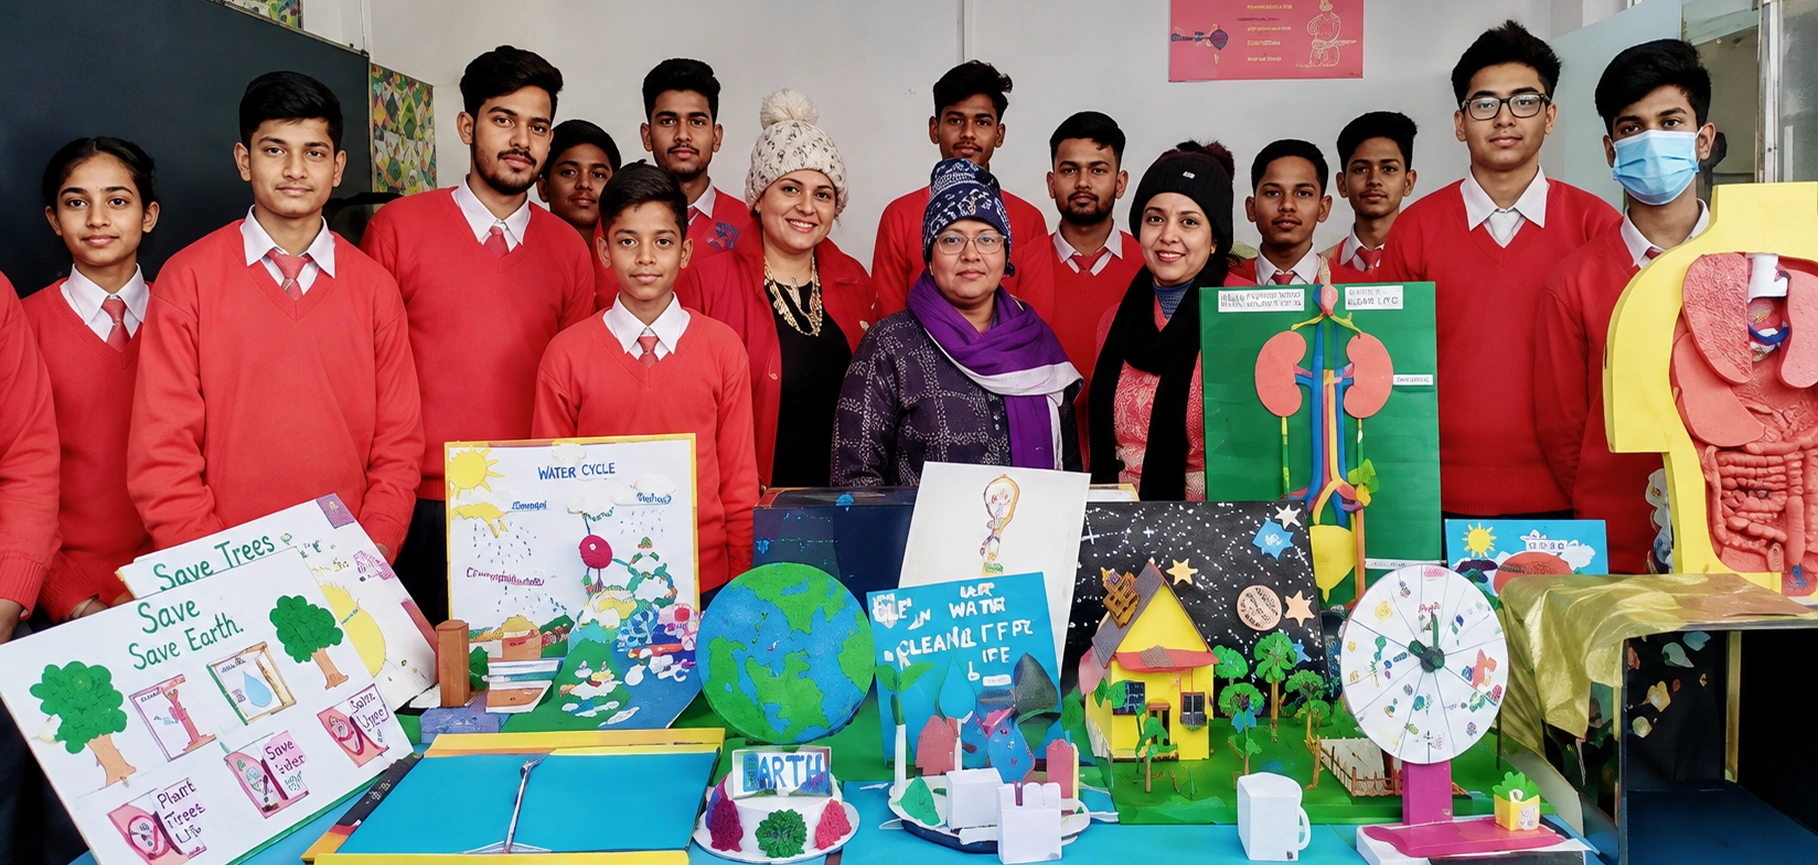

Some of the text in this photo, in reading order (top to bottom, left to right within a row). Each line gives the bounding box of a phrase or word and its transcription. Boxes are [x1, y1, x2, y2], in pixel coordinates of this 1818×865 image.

[538, 462, 616, 480] WATER CYCLE
[153, 535, 275, 592] Save Trees
[137, 600, 200, 634] Save
[128, 642, 181, 670] Save
[184, 612, 244, 651] Earth.
[265, 741, 295, 760] Save
